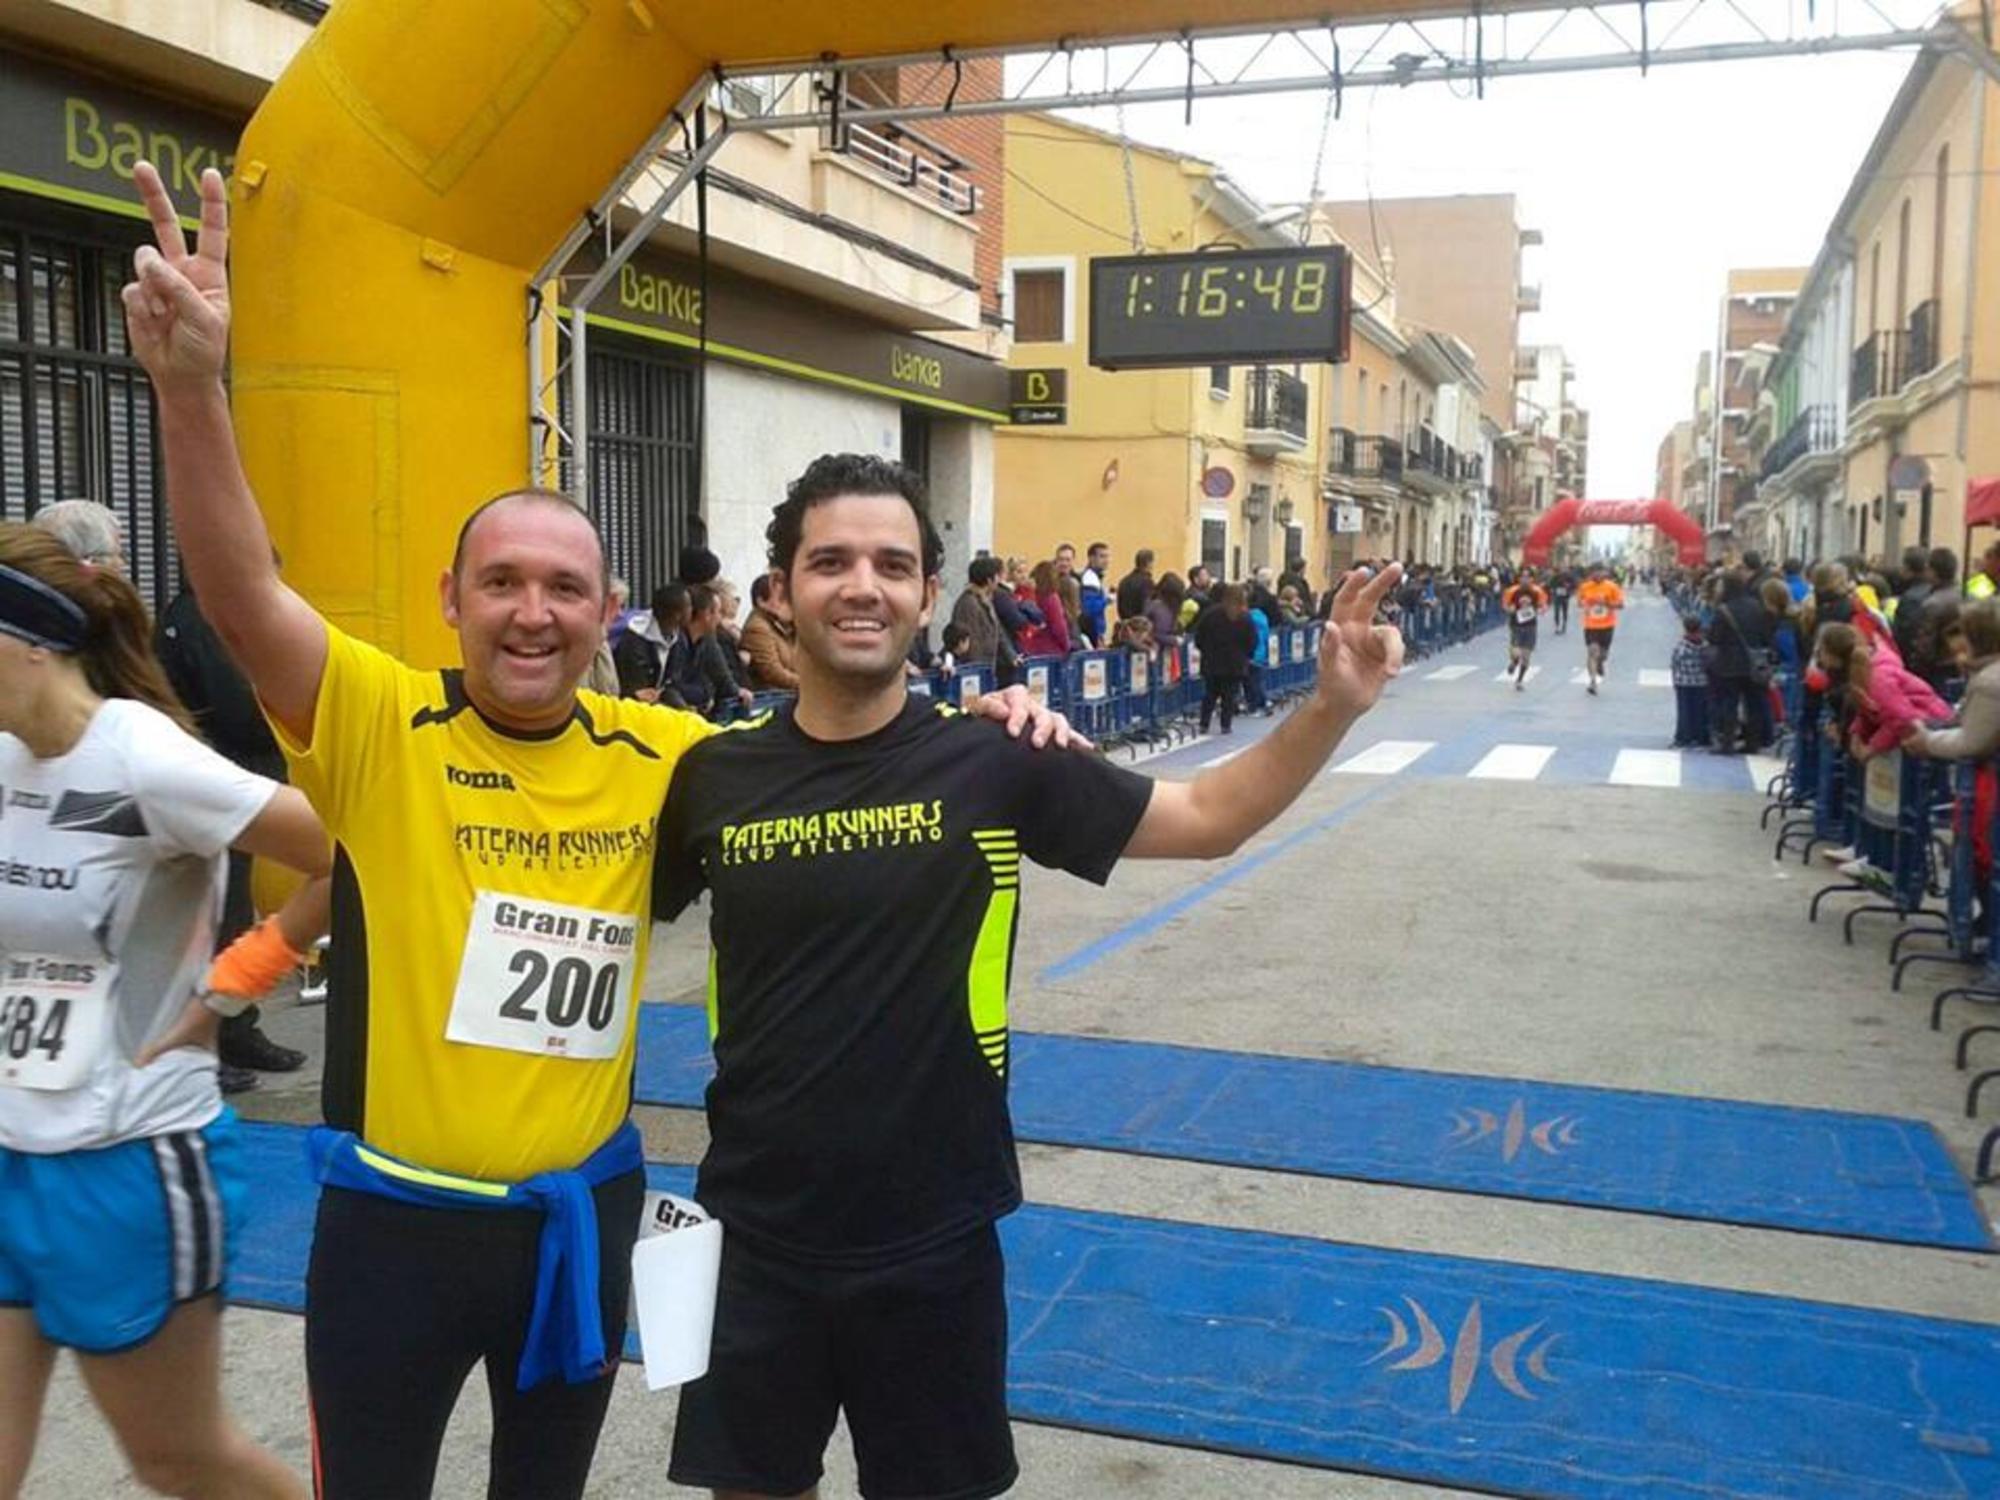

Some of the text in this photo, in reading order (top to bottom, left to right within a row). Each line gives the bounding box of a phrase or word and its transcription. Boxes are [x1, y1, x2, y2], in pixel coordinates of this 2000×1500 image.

[621, 263, 702, 326] Bankia
[1127, 263, 1326, 318] 1:16:48
[892, 344, 942, 389] Bankia
[1028, 372, 1050, 401] B
[722, 800, 943, 850] PATERNA RUNNERS
[493, 901, 580, 939] Gran
[498, 948, 621, 1032] 200
